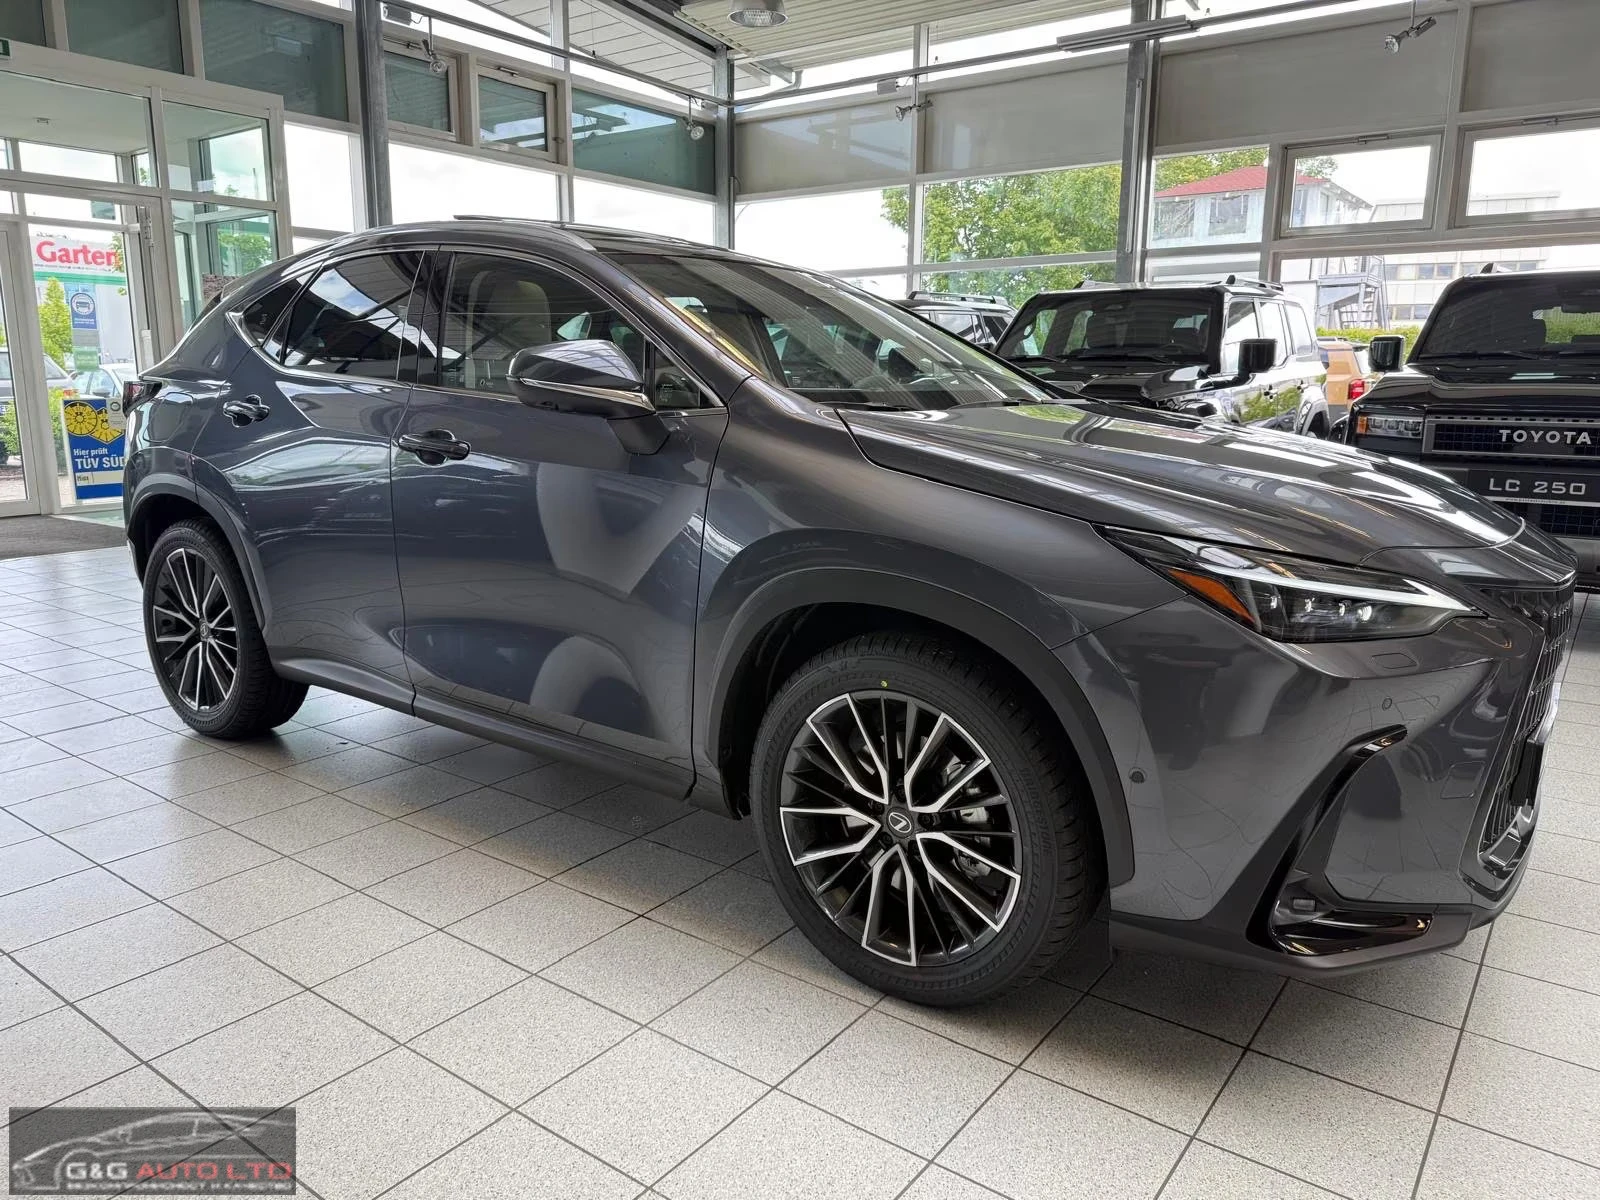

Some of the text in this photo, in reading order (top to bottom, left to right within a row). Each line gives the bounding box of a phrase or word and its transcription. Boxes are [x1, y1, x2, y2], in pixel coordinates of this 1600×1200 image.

[36, 240, 118, 267] Garten
[1498, 429, 1592, 445] TOYOTA
[73, 447, 108, 457] Hier prüft
[75, 455, 99, 470] TÜV
[1489, 478, 1586, 495] LC 250
